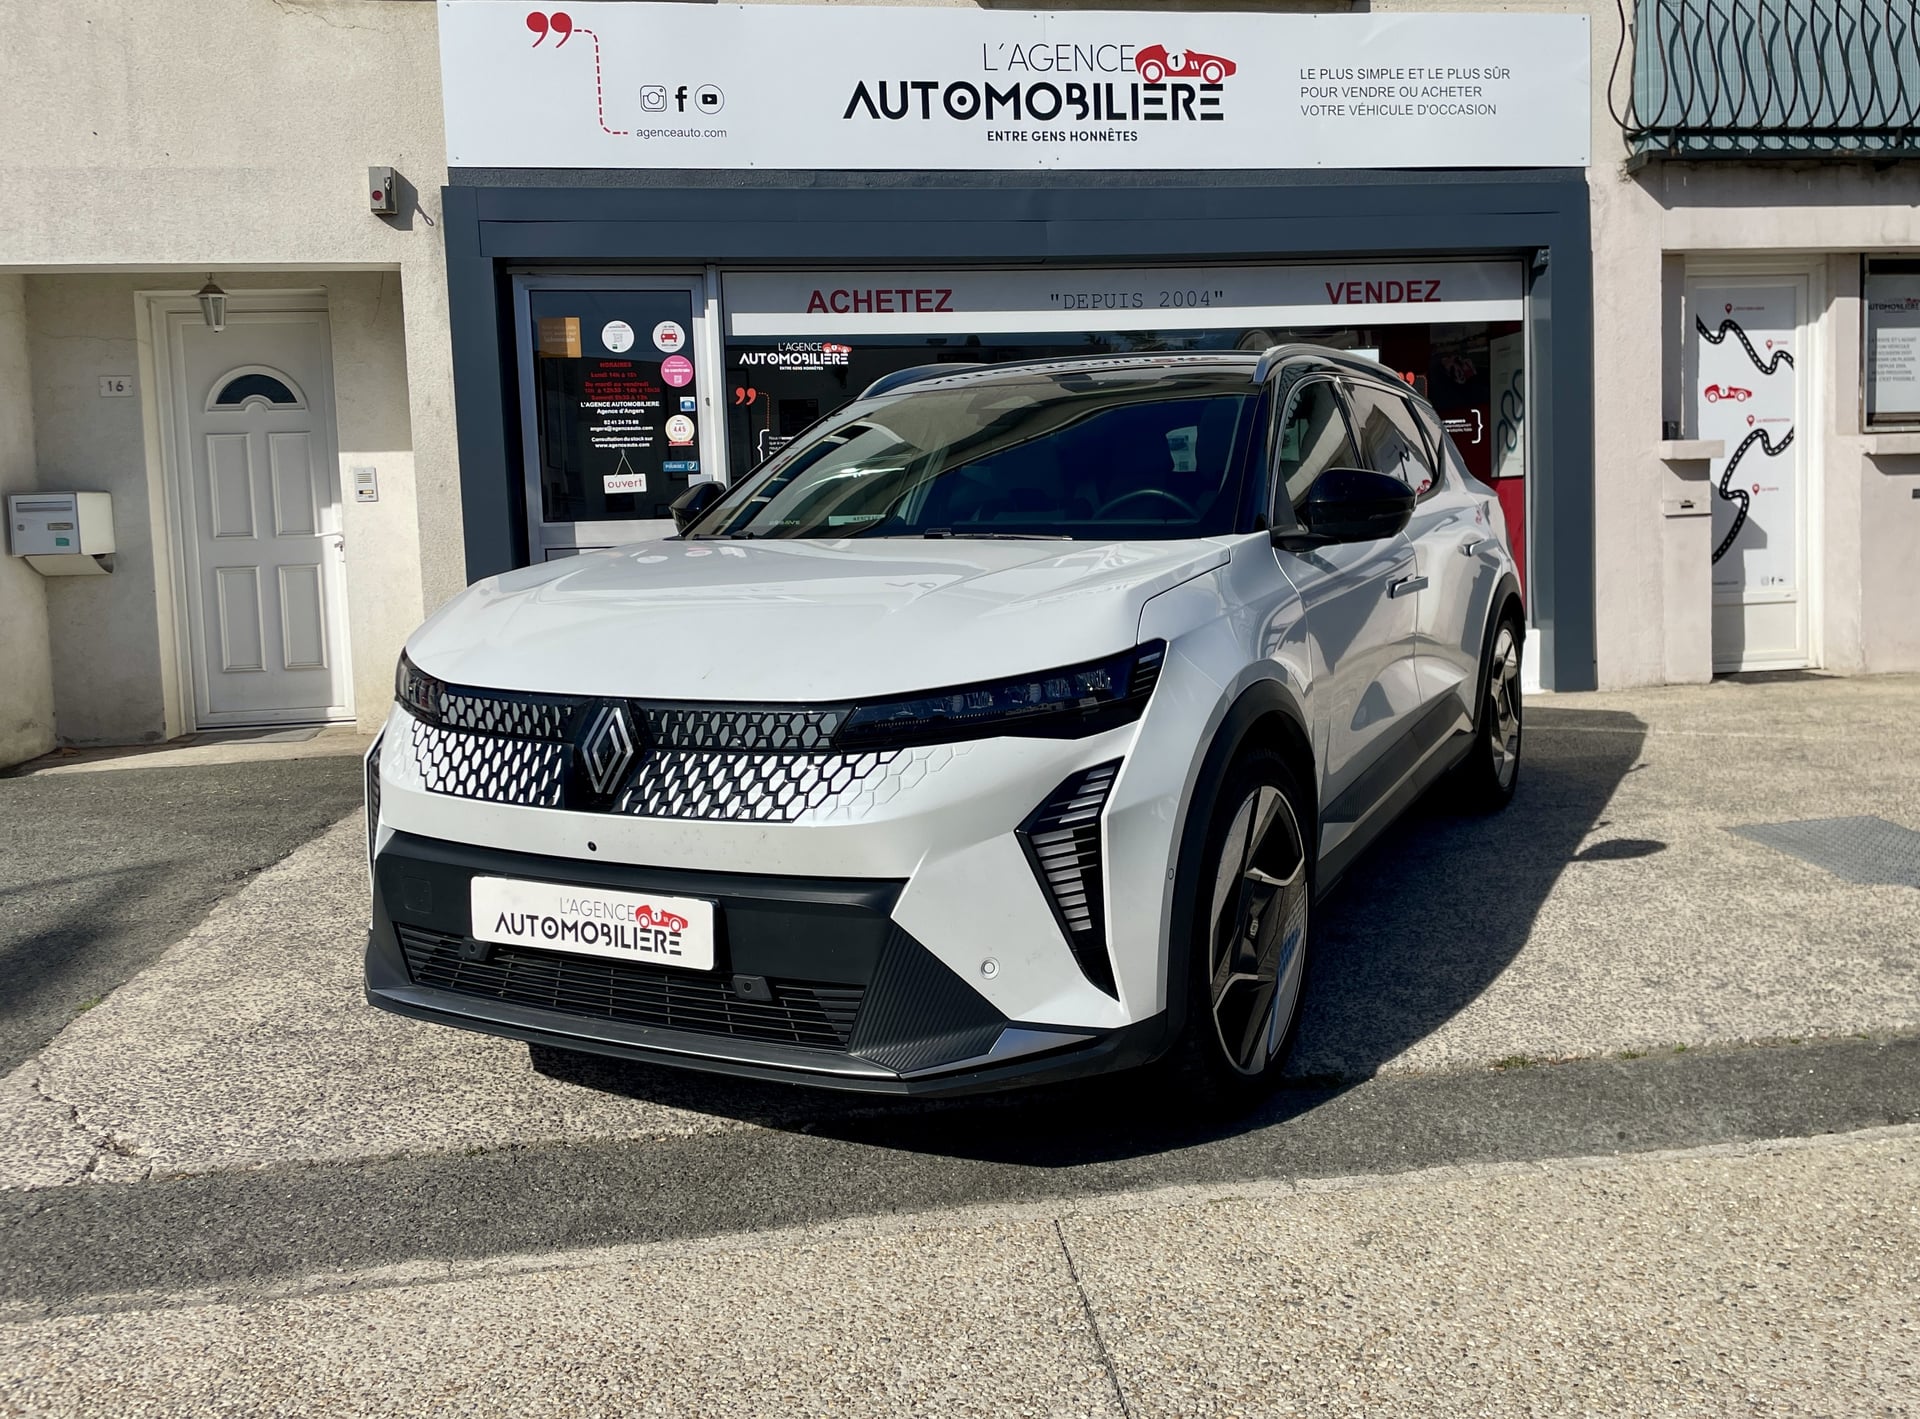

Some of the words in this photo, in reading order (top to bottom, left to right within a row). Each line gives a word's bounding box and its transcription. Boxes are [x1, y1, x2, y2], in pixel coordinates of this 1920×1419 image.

[983, 43, 1137, 72] L'AGENCE
[1300, 68, 1316, 80] LE
[1320, 68, 1353, 80] PLUS
[1357, 68, 1404, 80] SIMPLE
[1409, 68, 1424, 80] ET
[1428, 68, 1443, 80] LE
[1447, 68, 1480, 80] PLUS
[1484, 66, 1510, 80] SÛR
[1301, 86, 1338, 98] POUR
[1341, 86, 1395, 98] VENDRE
[1399, 86, 1418, 98] OU
[1421, 86, 1482, 98] ACHETER
[843, 80, 1224, 121] AUTOMOBILIERE
[1301, 104, 1345, 116] VOTRE
[1349, 103, 1413, 116] VÉHICULE
[1418, 104, 1497, 115] D'OCCASION
[636, 127, 727, 140] agenceauto.com
[987, 130, 1028, 142] ENTRE
[1031, 130, 1066, 142] GENS
[1070, 127, 1138, 142] HONNÊTES
[1050, 293, 1144, 309] "DEPUIS
[1159, 290, 1224, 308] 2004"
[1325, 280, 1441, 304] VENDEZ
[807, 289, 953, 313] ACHETEZ
[778, 343, 823, 352] L'AGENCE
[108, 380, 124, 392] 16
[607, 478, 643, 488] ouvert
[559, 897, 636, 922] L'AGENCE
[494, 912, 682, 956] AUTOMOBILIERE
